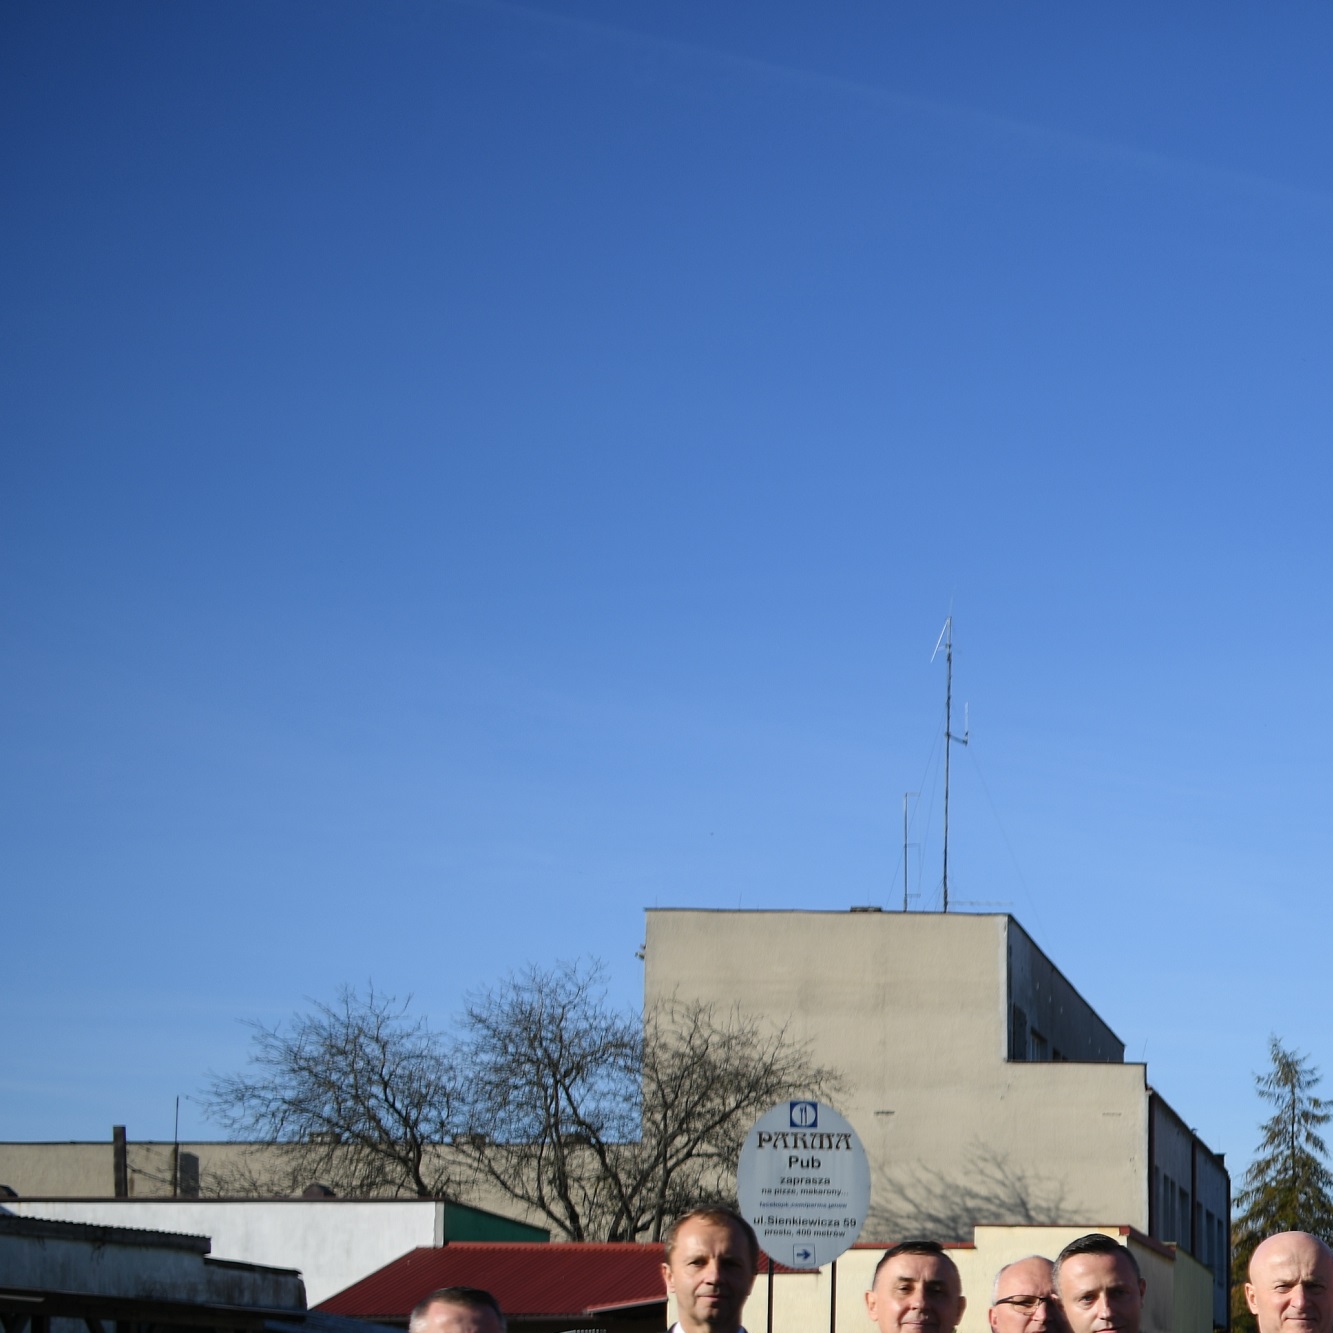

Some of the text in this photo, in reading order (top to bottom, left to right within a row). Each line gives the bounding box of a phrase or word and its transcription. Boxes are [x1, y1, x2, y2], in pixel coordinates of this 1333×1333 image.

[757, 1131, 852, 1150] PARMA
[789, 1155, 821, 1169] Pub
[780, 1176, 830, 1186] zaprasza
[761, 1187, 772, 1195] na
[796, 1228, 812, 1236] 400
